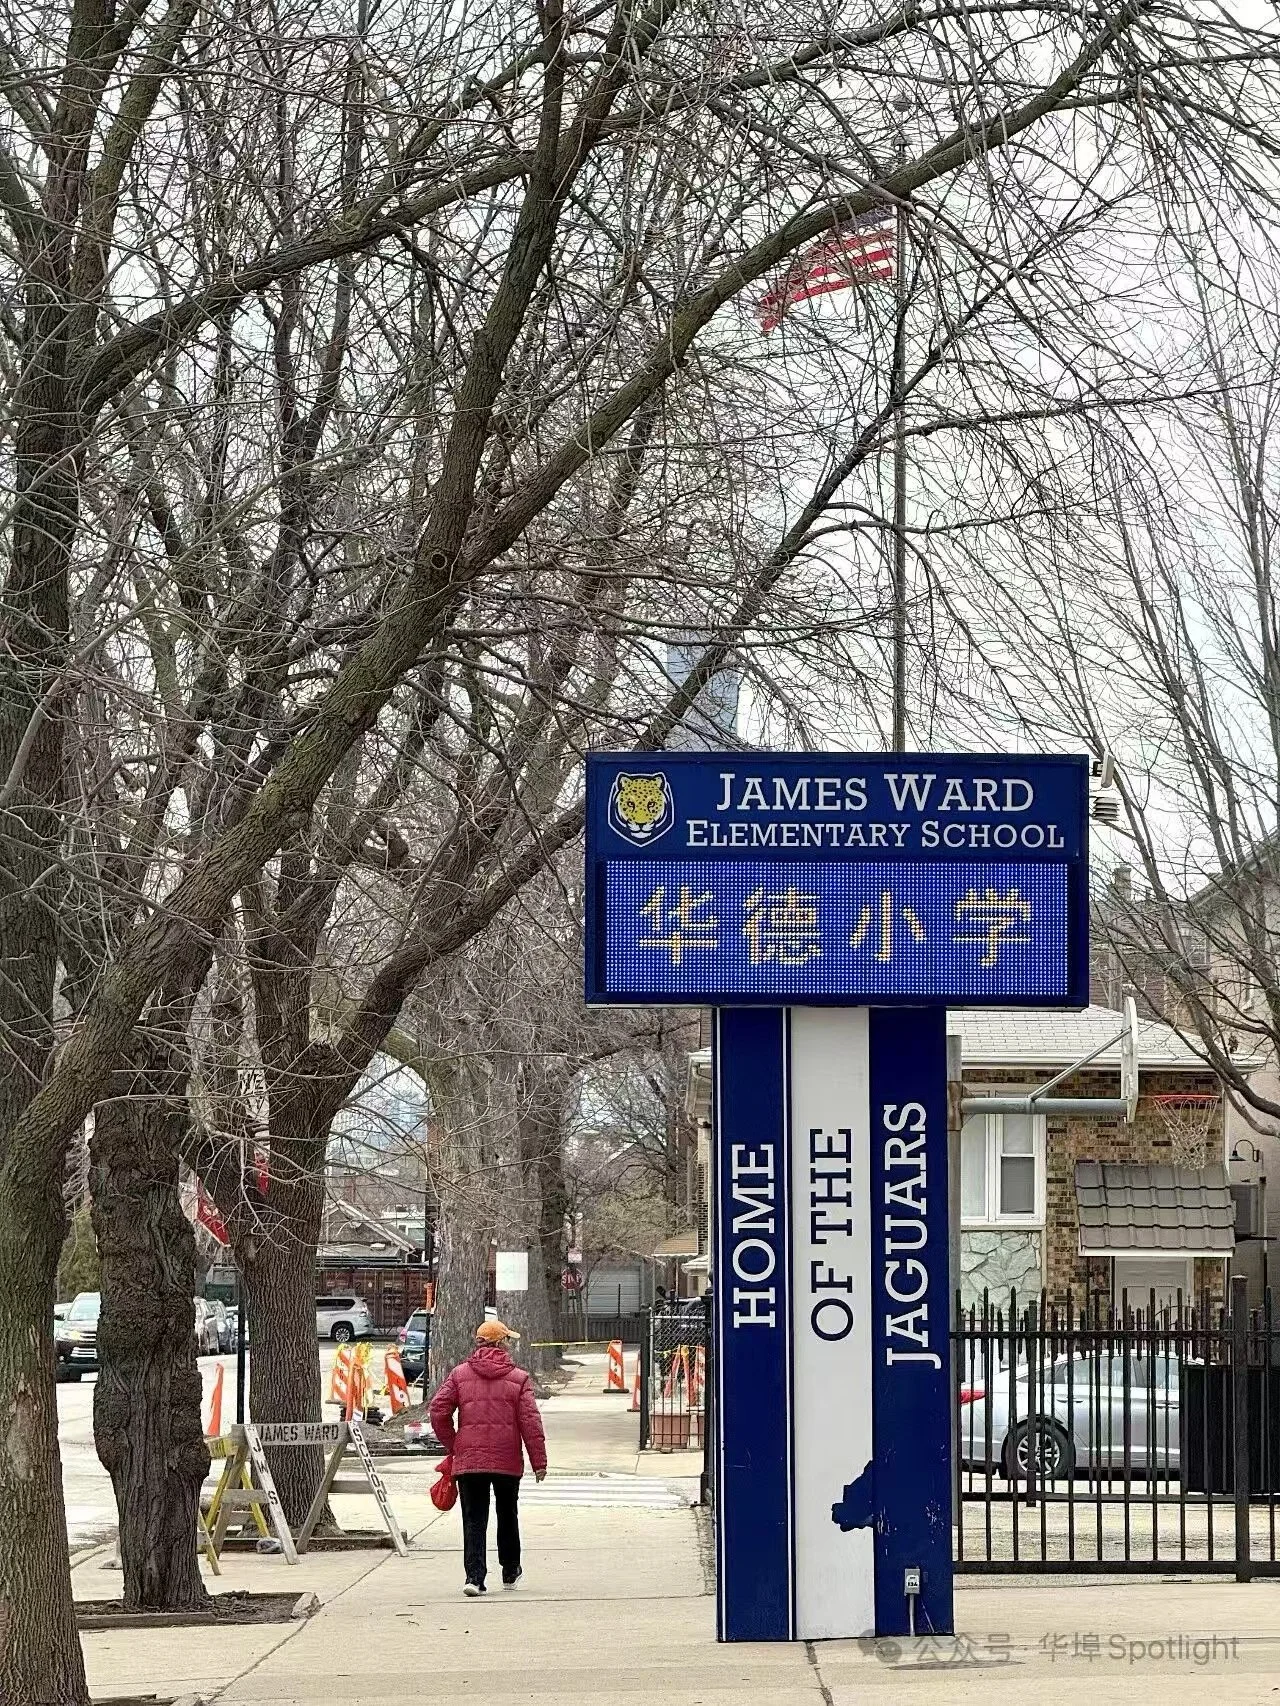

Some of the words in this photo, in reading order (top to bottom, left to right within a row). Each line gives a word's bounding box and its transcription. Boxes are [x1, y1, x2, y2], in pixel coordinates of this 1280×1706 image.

[716, 773, 867, 811] JAMES
[884, 774, 1034, 812] WARD
[686, 819, 910, 848] ELEMENTARY
[921, 820, 1065, 849] SCHOOL
[639, 885, 1033, 967] 华德小学
[809, 1129, 853, 1245] THE
[731, 1144, 776, 1328] HOME
[883, 1102, 942, 1369] JAGUARS
[810, 1260, 854, 1341] OF
[259, 1424, 299, 1443] JAMES
[304, 1424, 339, 1441] WARD
[352, 1427, 393, 1519] SCHOOL
